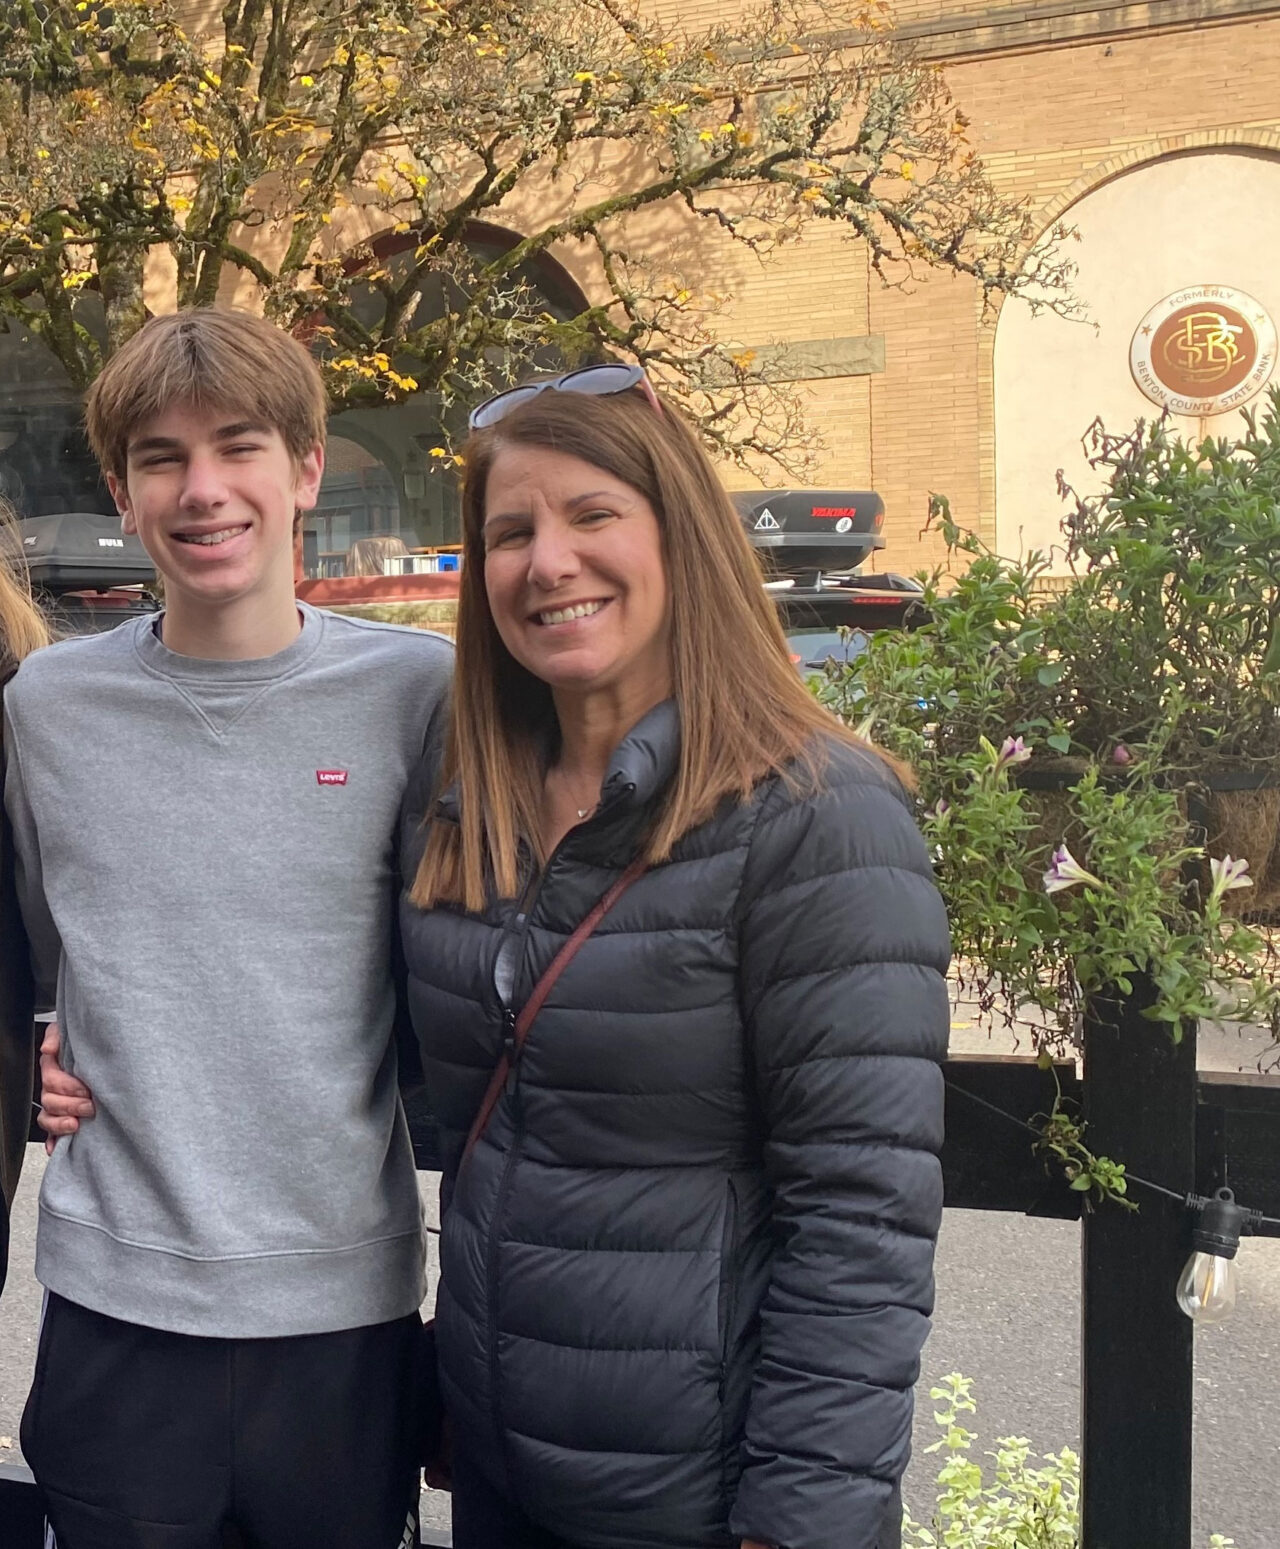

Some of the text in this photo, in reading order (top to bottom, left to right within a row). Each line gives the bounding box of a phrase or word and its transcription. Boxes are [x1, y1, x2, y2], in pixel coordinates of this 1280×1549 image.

[1169, 289, 1234, 307] FORMERLY
[1137, 353, 1271, 412] BENTON COUNTY STATE BANK
